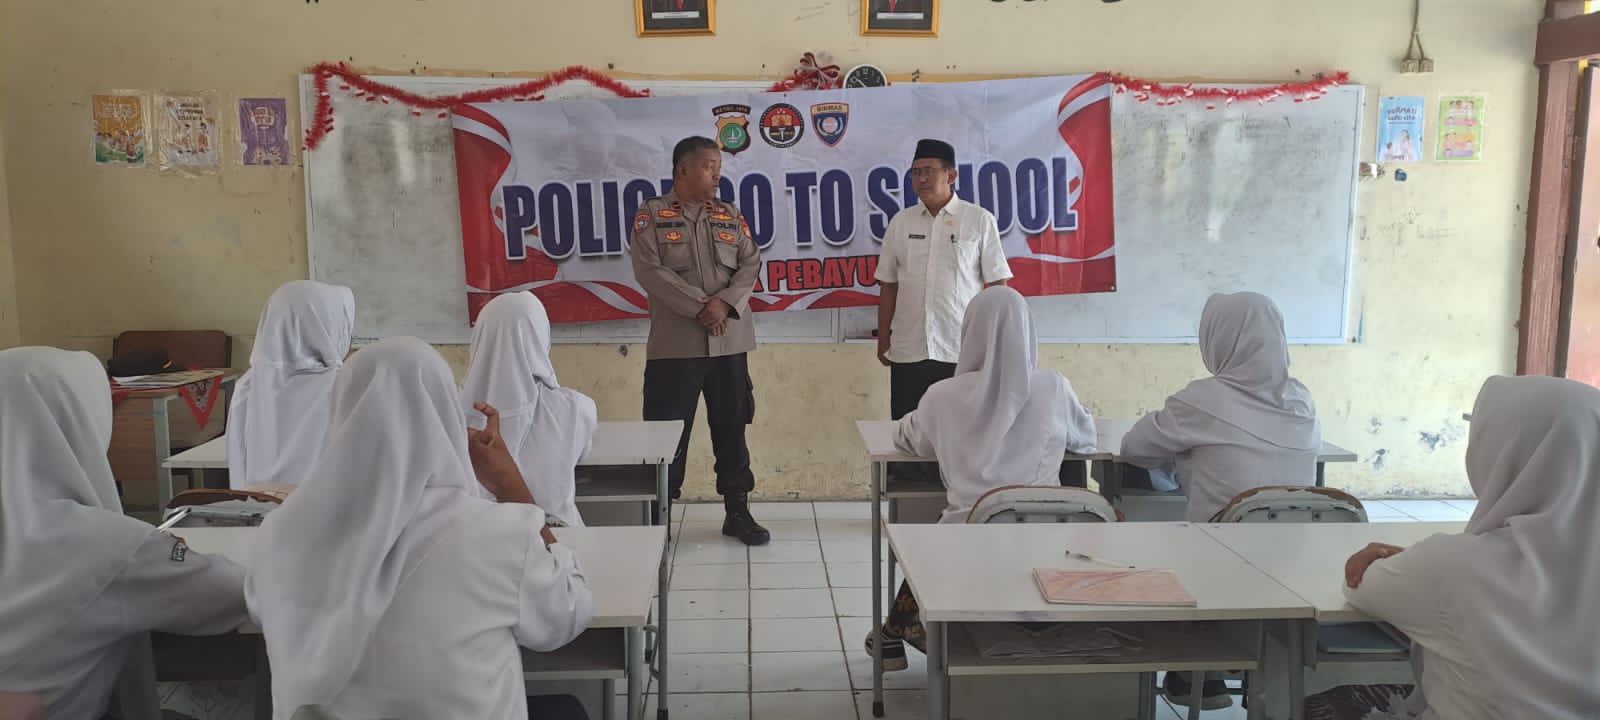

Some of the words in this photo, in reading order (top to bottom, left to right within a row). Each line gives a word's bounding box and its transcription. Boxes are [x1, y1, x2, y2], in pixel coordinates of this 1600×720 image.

[816, 104, 842, 112] BINMAS
[785, 168, 855, 243] TO
[867, 157, 1077, 240] SOOL
[710, 222, 737, 232] POLRI
[767, 254, 881, 292] PEBAYU
